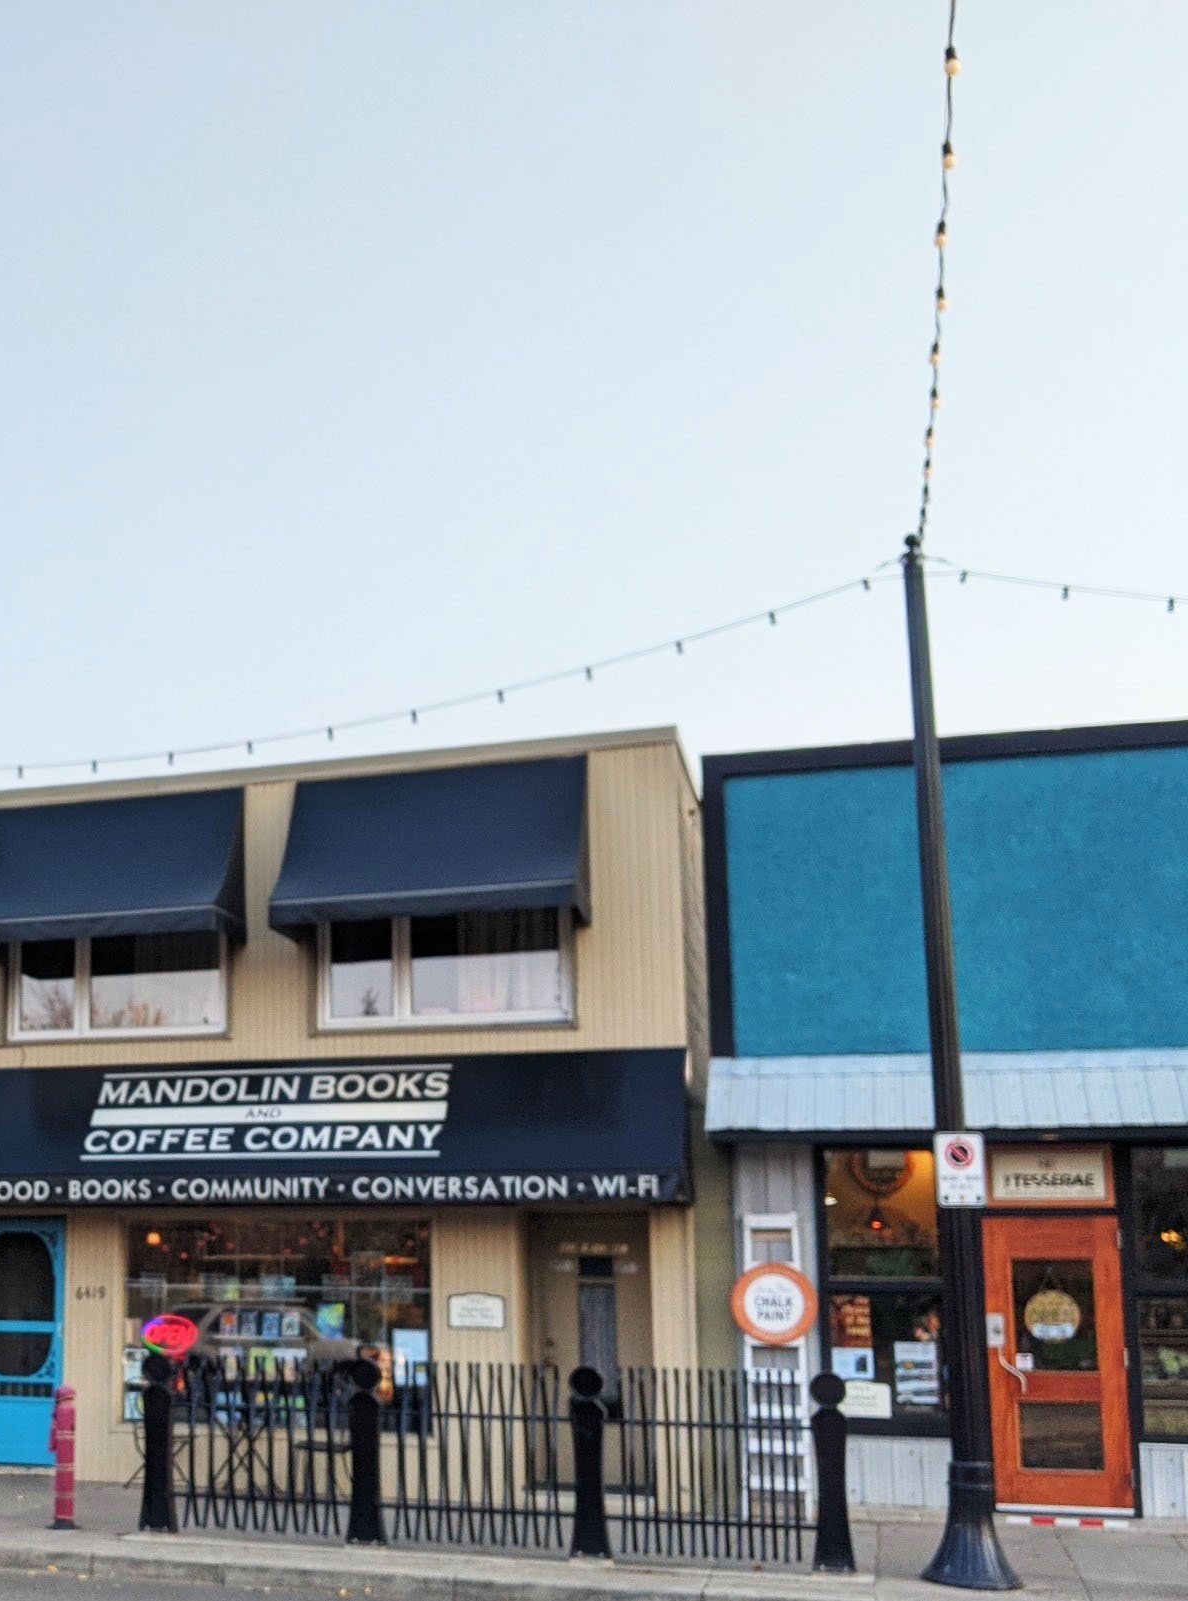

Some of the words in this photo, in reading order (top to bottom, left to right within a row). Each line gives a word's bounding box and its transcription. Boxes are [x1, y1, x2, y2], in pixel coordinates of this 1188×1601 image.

[98, 1075, 301, 1106] MANDOLIN
[308, 1072, 450, 1101] BOOKS
[244, 1107, 282, 1120] AND
[83, 1125, 236, 1154] COFFEE
[243, 1123, 443, 1151] COMPANY
[67, 1178, 152, 1201] BOOKS
[170, 1176, 330, 1200] COMMUNITY
[351, 1175, 569, 1200] CONVERSATION
[592, 1174, 660, 1199] WI-FI
